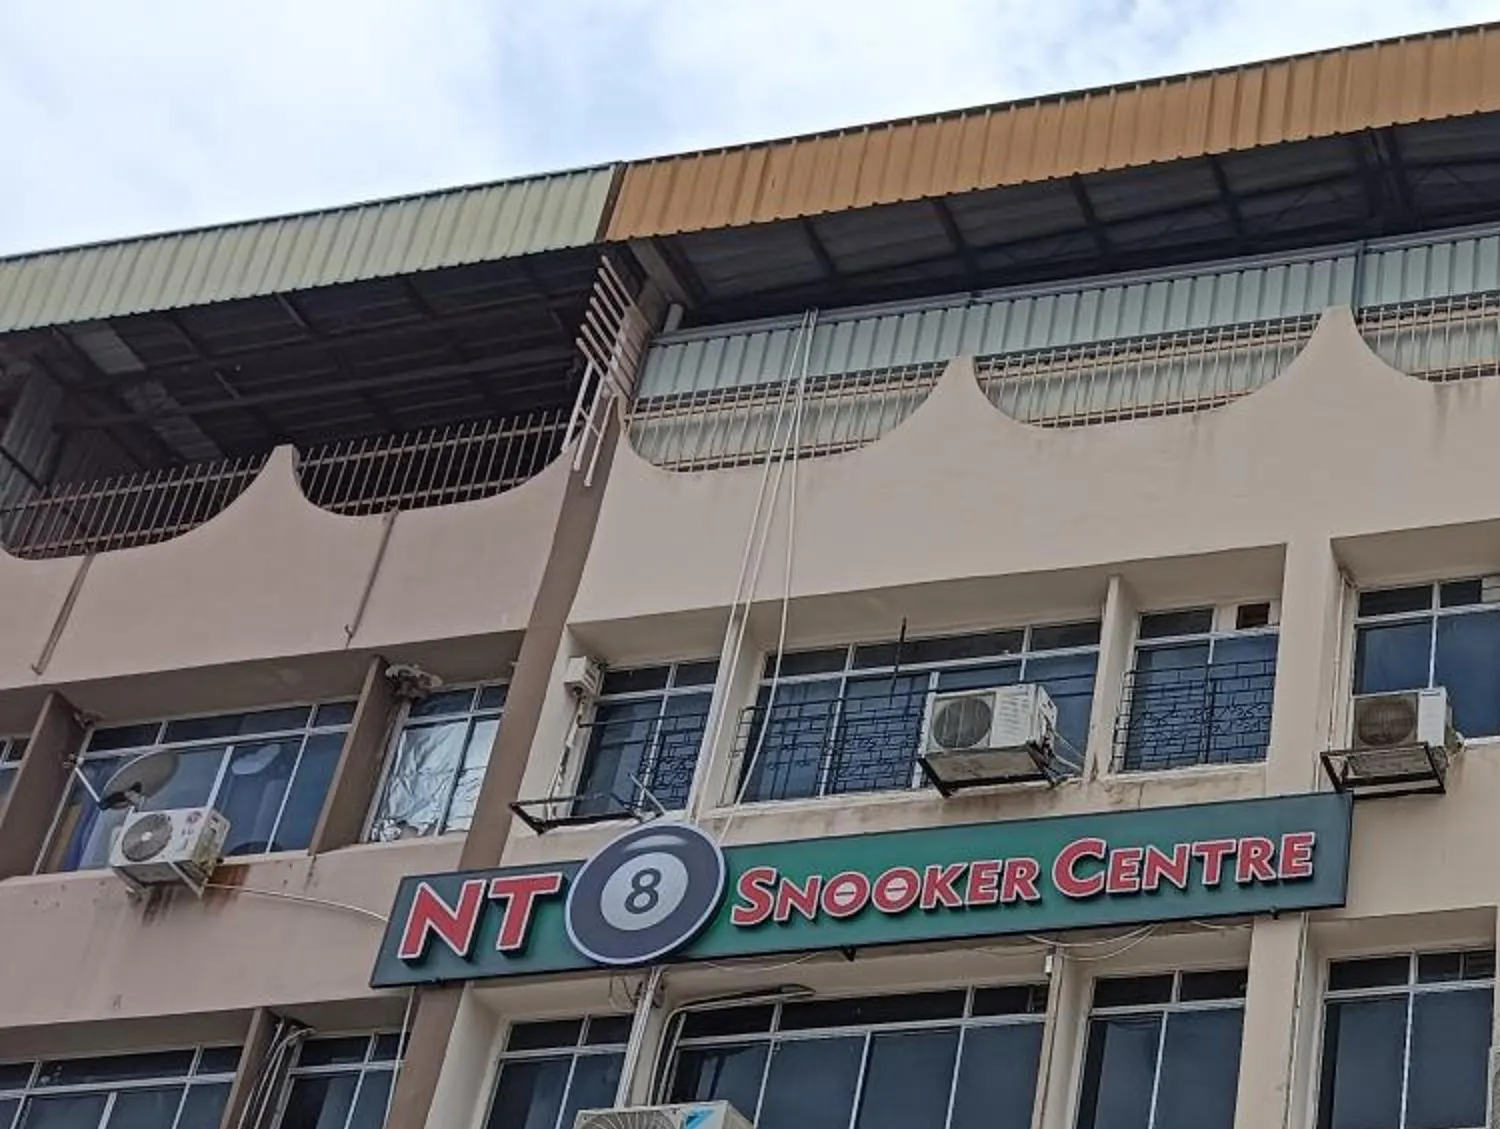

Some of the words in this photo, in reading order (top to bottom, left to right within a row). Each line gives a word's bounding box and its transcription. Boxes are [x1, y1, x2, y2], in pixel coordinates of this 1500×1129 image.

[397, 871, 564, 960] NT
[624, 867, 662, 915] 8
[730, 856, 1041, 926] SNOOKER
[1052, 831, 1316, 899] CENTRE
